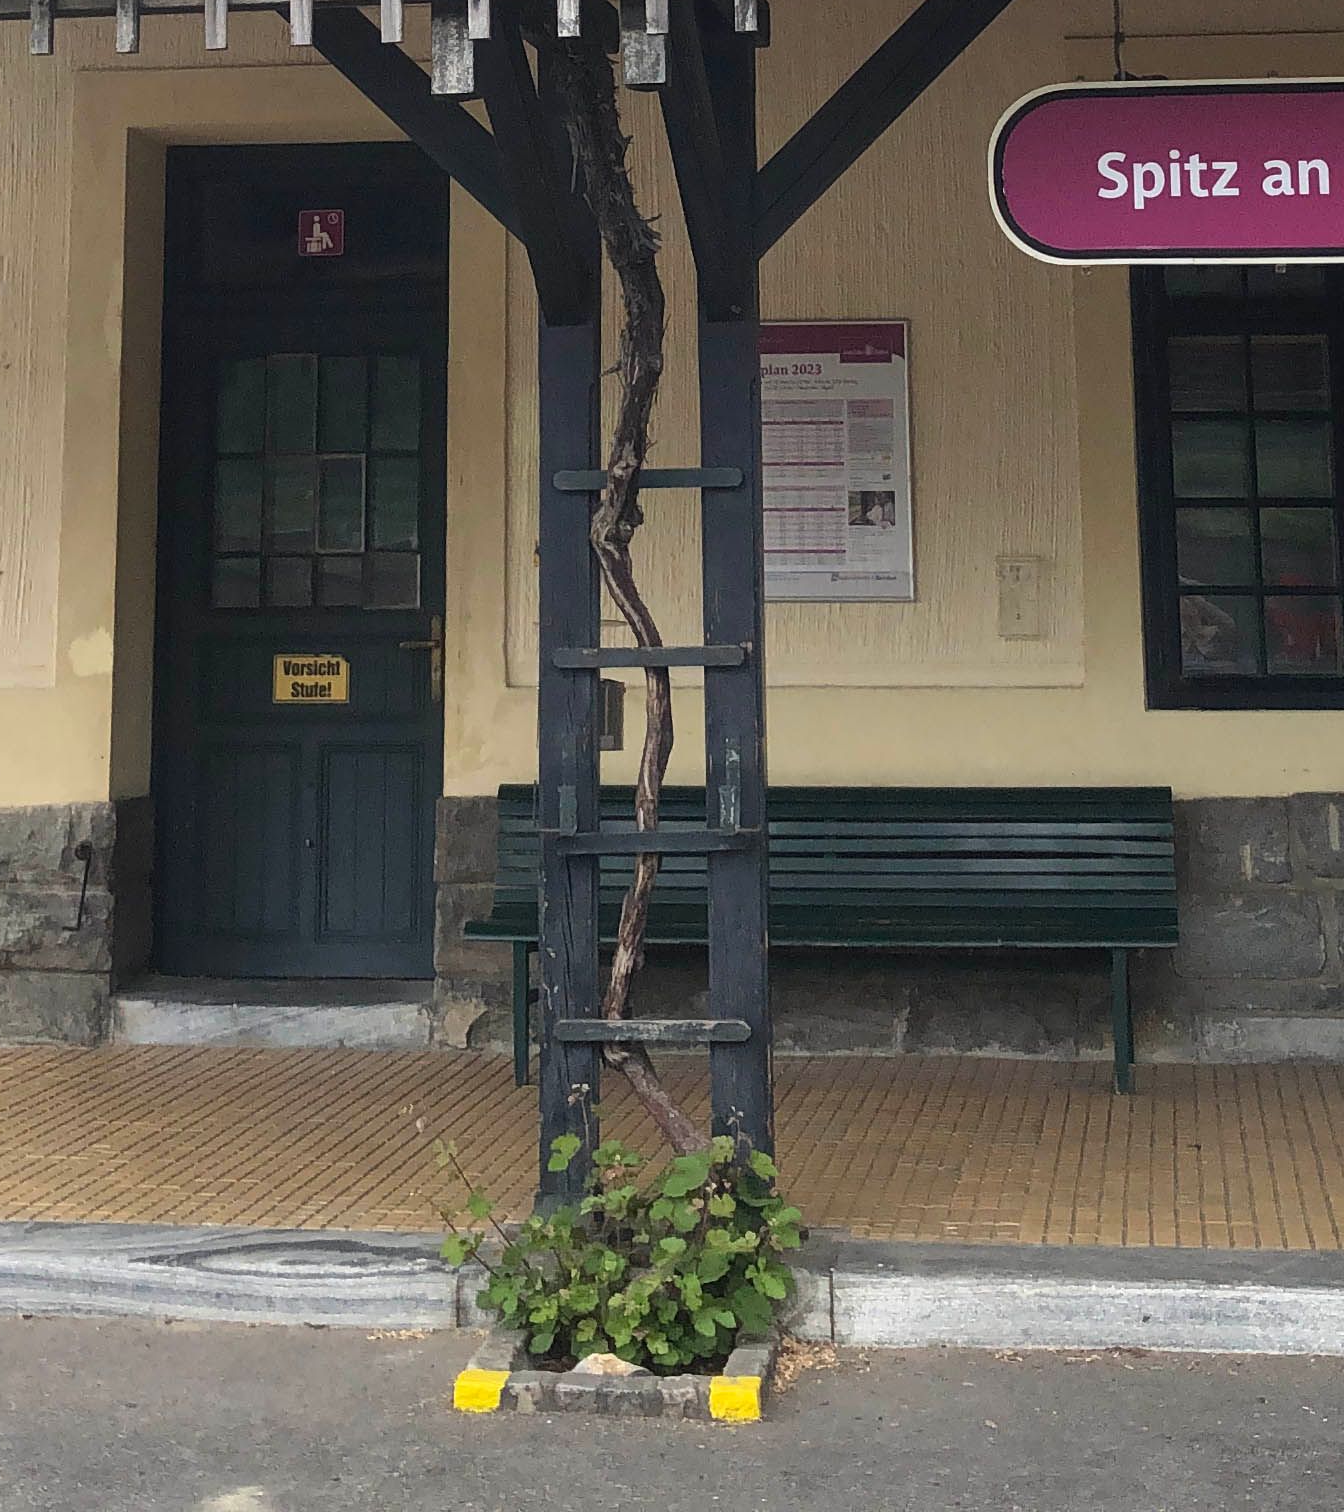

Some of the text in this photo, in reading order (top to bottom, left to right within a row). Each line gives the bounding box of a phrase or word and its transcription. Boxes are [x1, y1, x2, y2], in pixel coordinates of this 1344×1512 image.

[1097, 148, 1241, 210] Spitz
[1262, 156, 1331, 197] an
[791, 363, 822, 376] 2023
[283, 660, 341, 676] Vorsicht
[291, 681, 332, 698] Stufe!
